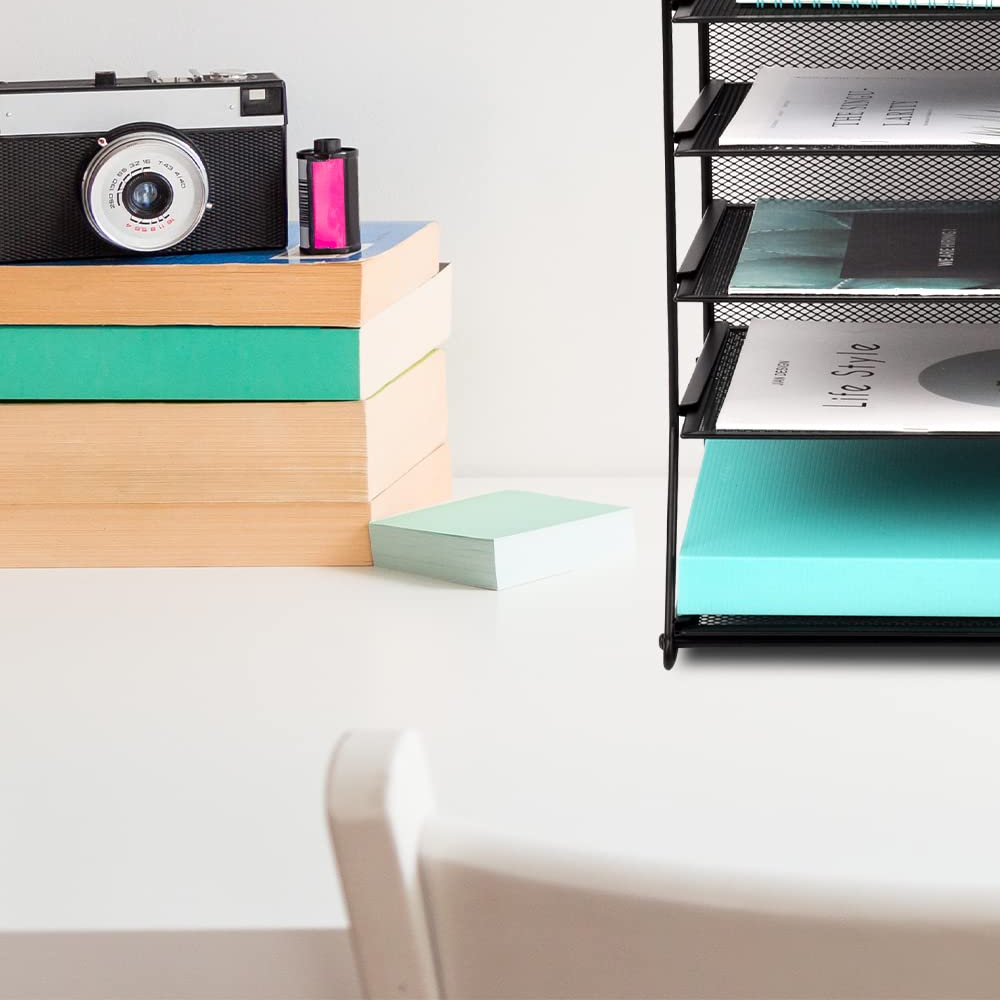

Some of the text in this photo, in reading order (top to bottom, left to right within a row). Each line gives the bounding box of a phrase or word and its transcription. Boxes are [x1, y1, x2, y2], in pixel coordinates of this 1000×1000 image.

[832, 88, 875, 127] THE SINGU-
[882, 101, 919, 126] LARITY
[128, 160, 140, 169] 32
[937, 258, 953, 267] WE
[822, 343, 886, 407] Life Style
